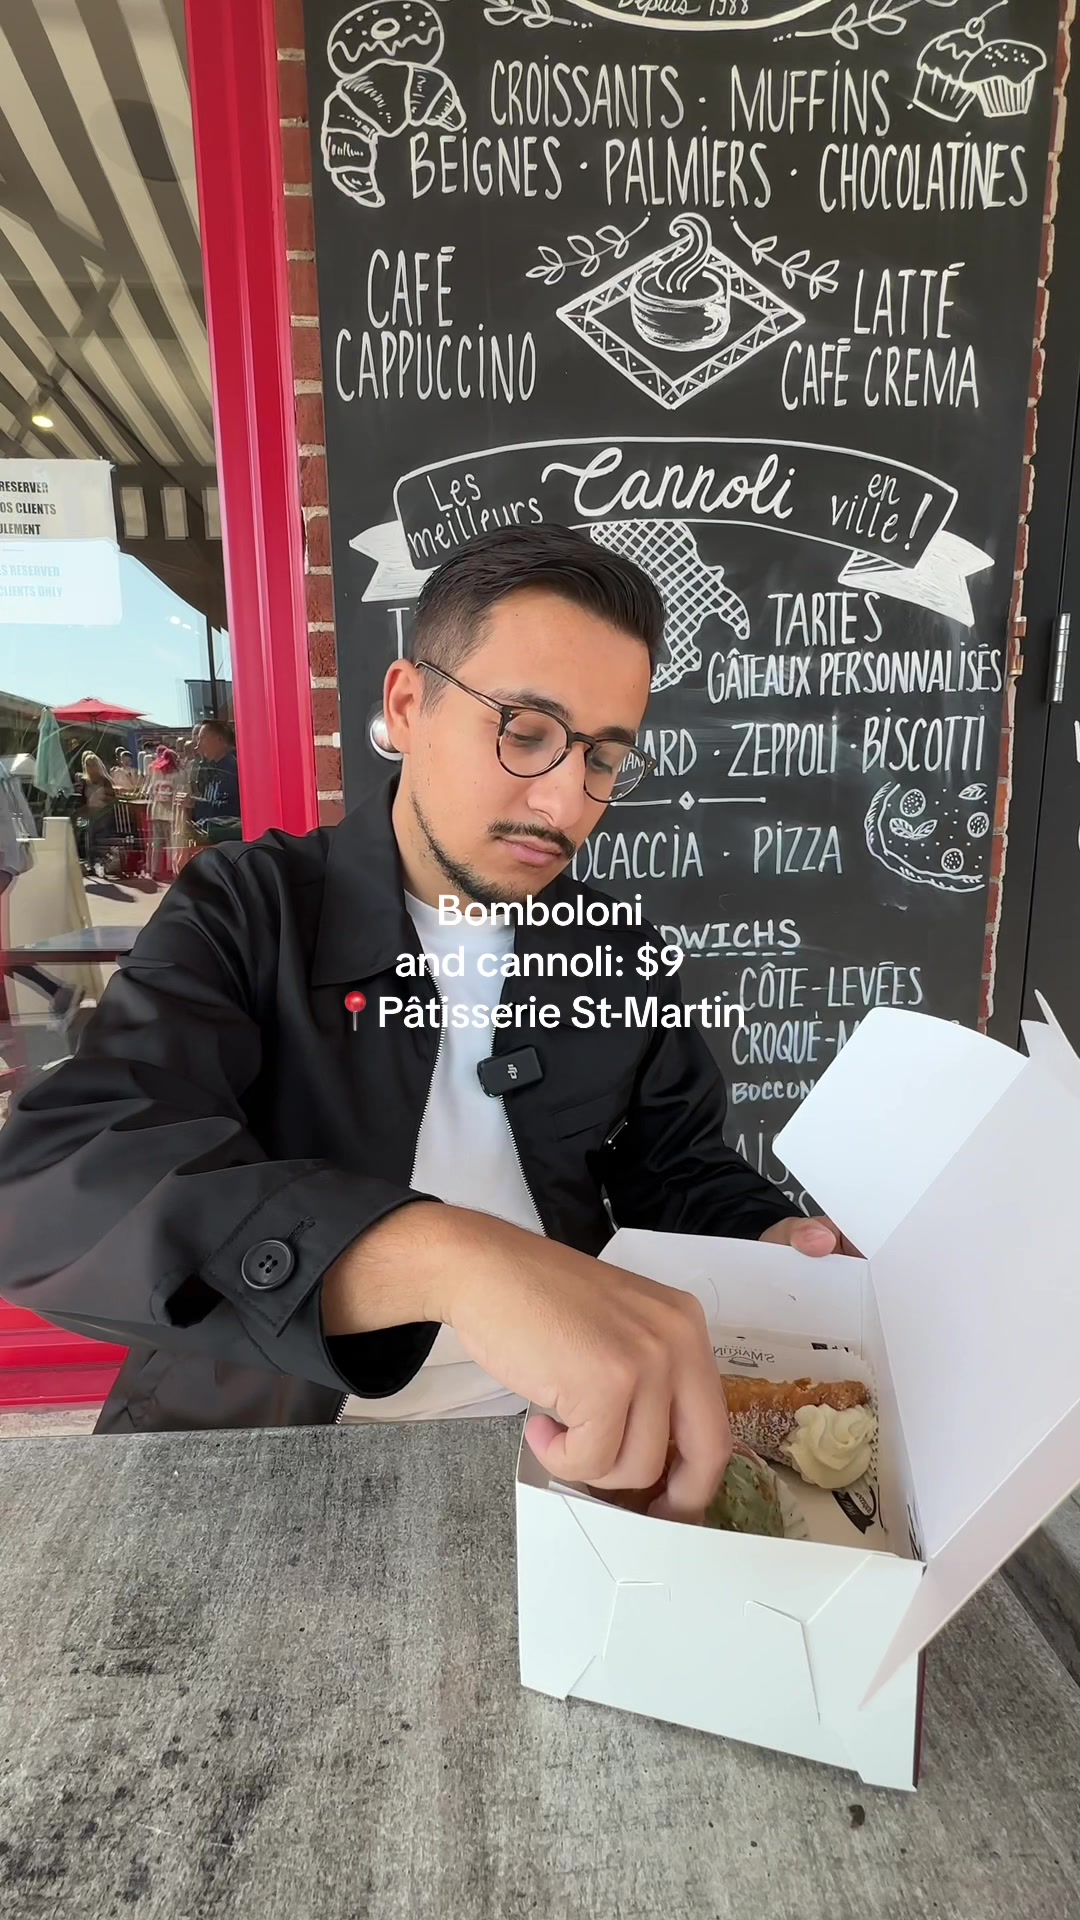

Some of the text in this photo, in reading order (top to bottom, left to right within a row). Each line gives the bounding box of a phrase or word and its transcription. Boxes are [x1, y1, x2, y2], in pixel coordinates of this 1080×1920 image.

[490, 54, 890, 137] CROISSANTS MUFFINS
[410, 125, 1028, 213] BEIGNES PALMIERS CHOCOLATINES
[367, 246, 456, 329] CAFÉ
[854, 262, 966, 340] LATTÉ
[335, 323, 536, 404] CAPPUCCINO
[781, 338, 979, 411] CAFÉ CREMA
[0, 502, 57, 515] OS CLIENTS
[426, 473, 481, 512] Les
[541, 447, 797, 519] Cannoli
[867, 473, 900, 503] en
[407, 497, 544, 559] meilleurs
[768, 591, 883, 647] TARTES
[707, 642, 1002, 704] GÂTEAUX PERSONNALISÉS
[728, 714, 838, 777] ZEPPOLI
[862, 704, 985, 773] BISCOTTI
[571, 821, 843, 883] OCACCIA PIZZA
[654, 919, 801, 950] DWICHS
[732, 1080, 815, 1104] BOCCON
